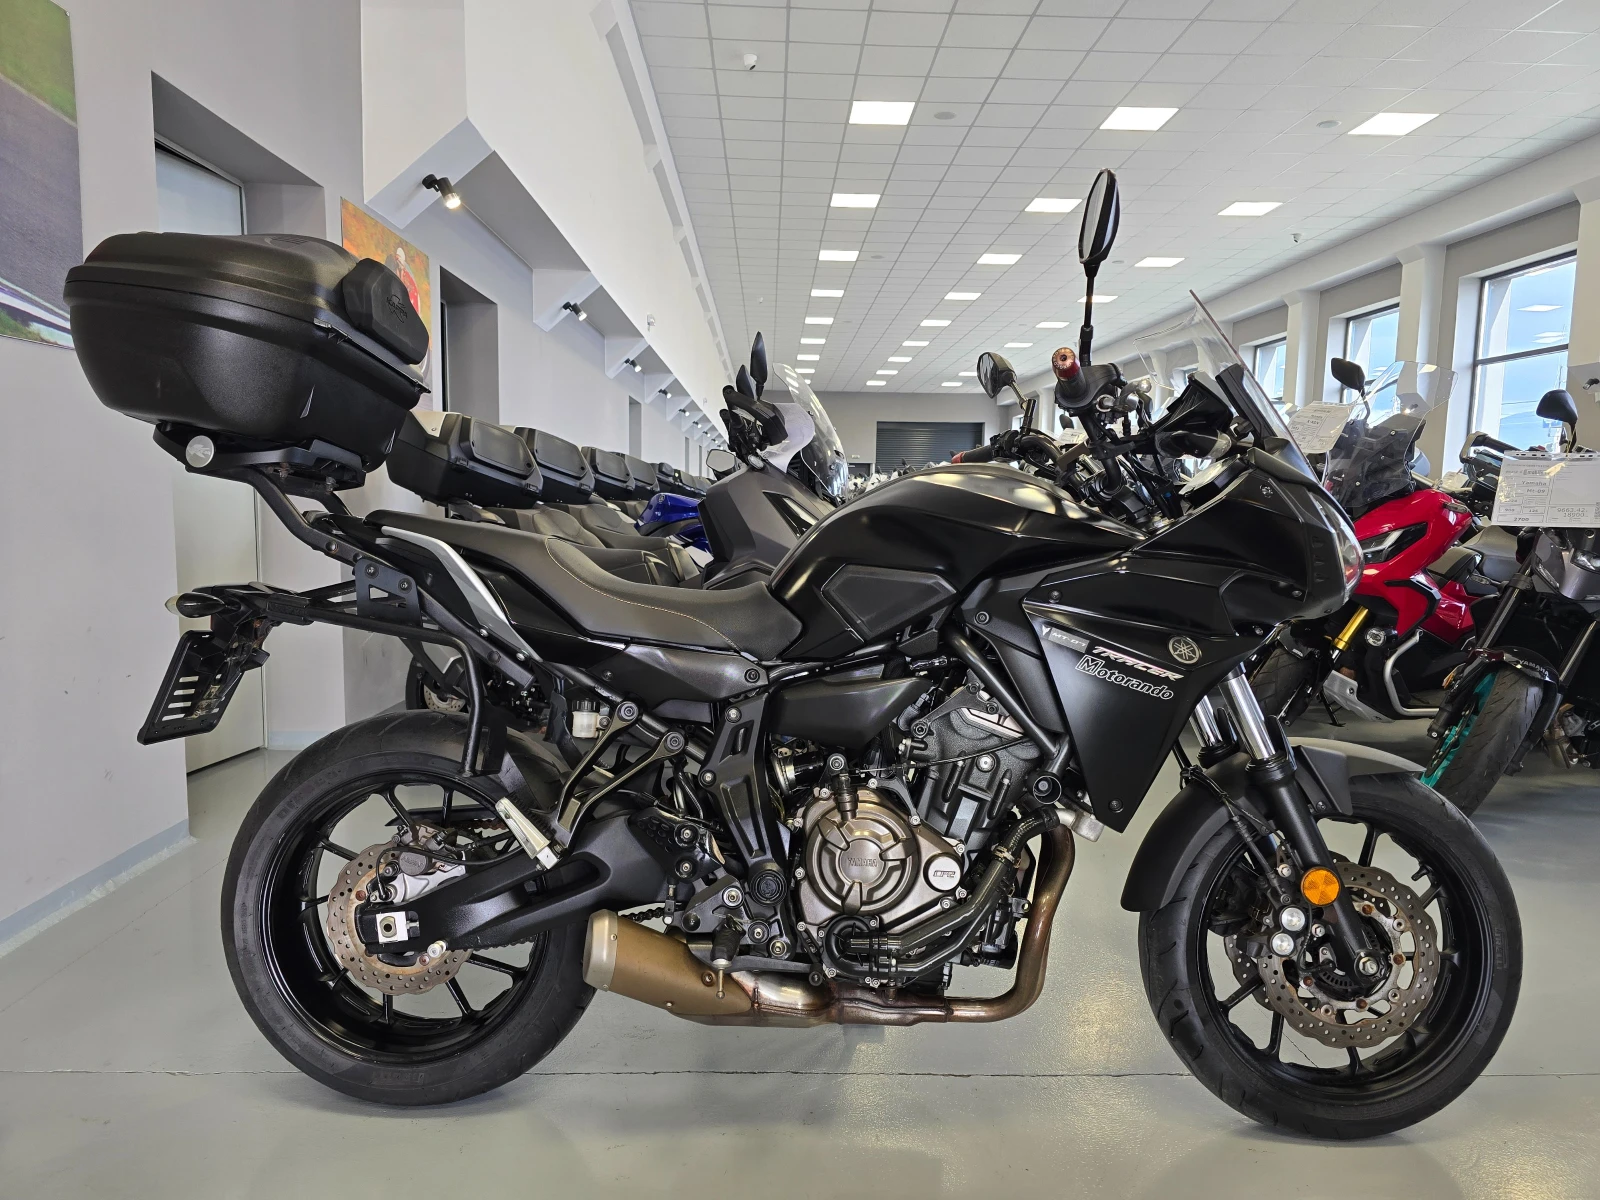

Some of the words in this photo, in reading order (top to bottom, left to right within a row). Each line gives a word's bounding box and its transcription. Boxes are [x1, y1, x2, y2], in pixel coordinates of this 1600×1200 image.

[1051, 631, 1087, 647] MT-07
[1092, 646, 1185, 681] TRACER
[1518, 659, 1549, 677] YAMAHA
[1075, 654, 1174, 700] Motorando
[847, 857, 878, 867] YAMAHA
